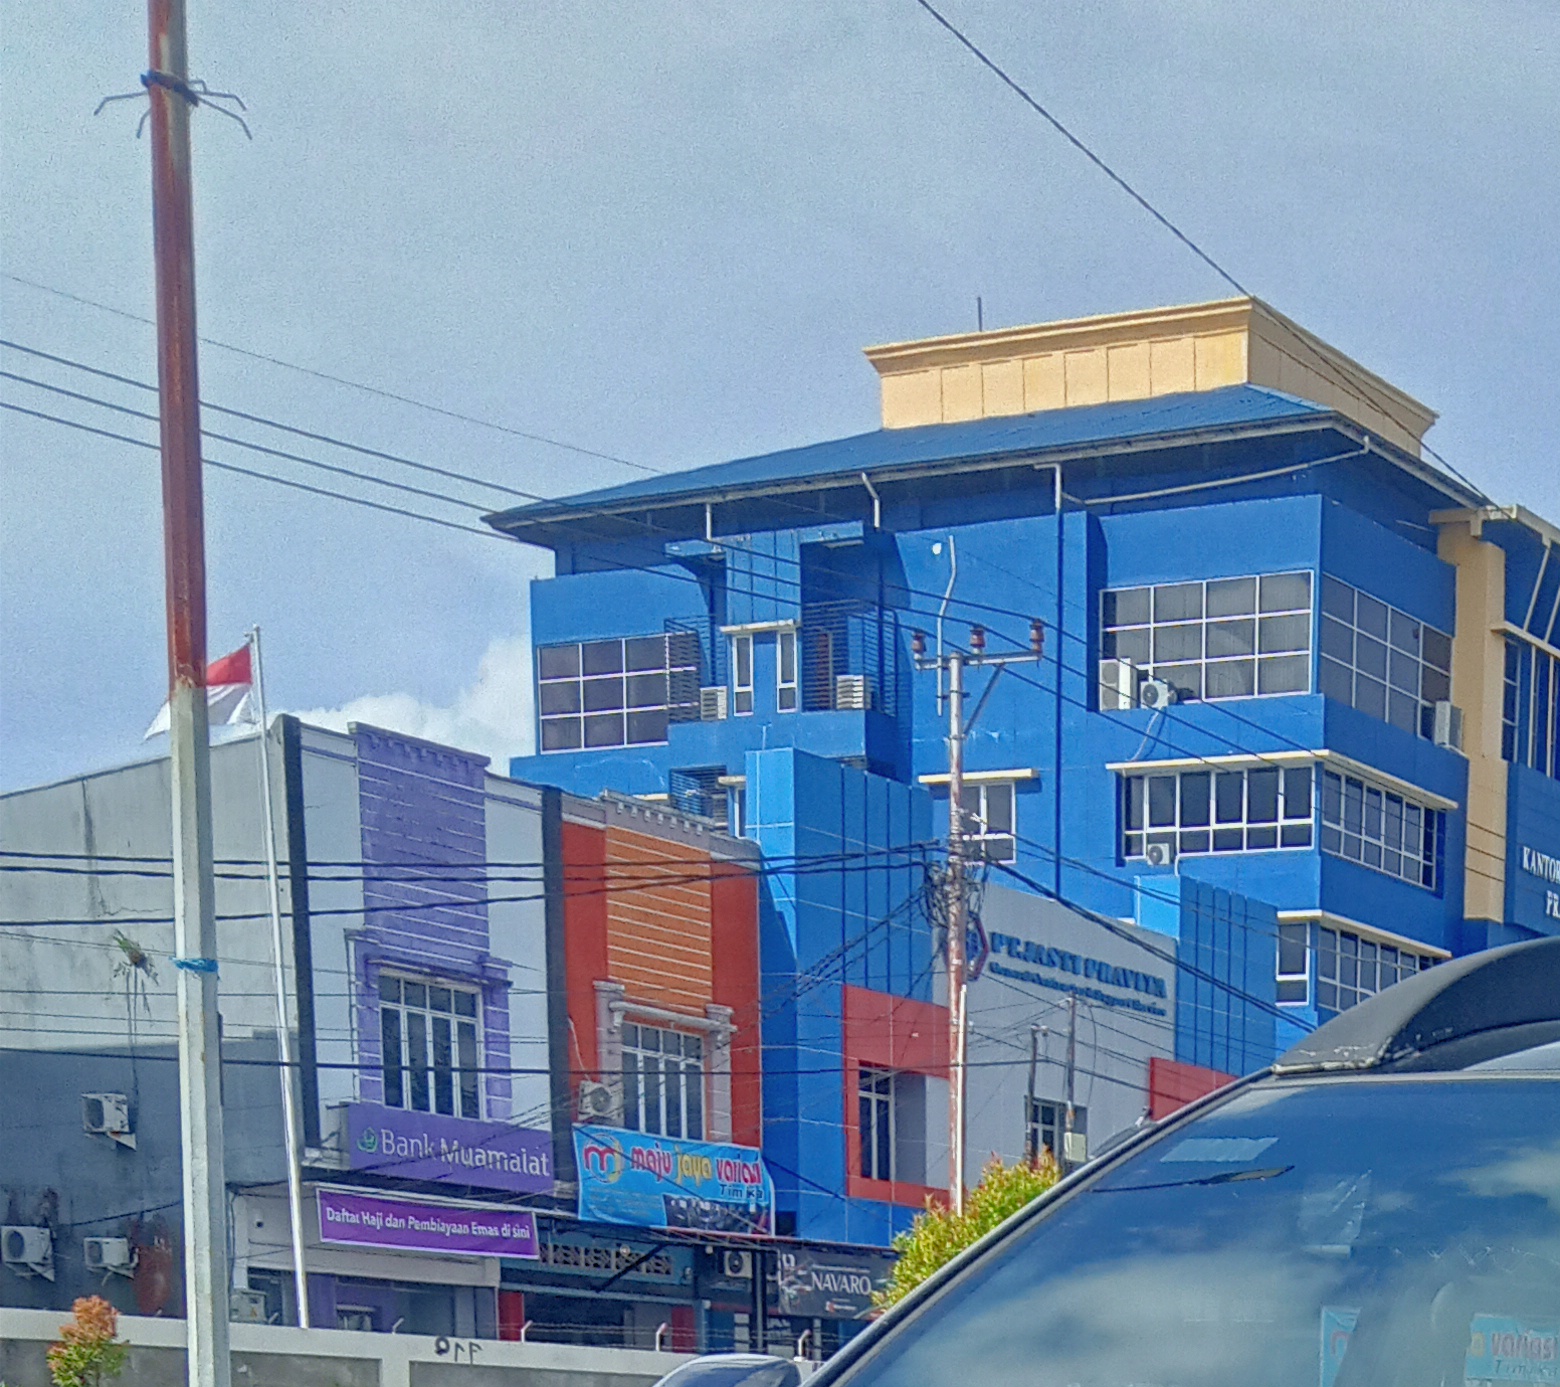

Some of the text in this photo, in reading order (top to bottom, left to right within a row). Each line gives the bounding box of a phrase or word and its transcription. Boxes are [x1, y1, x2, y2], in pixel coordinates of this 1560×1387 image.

[381, 1128, 550, 1177] Bank Muamalat
[631, 1141, 673, 1184] maju
[675, 1143, 713, 1188] jaya
[326, 1206, 530, 1240] Daftar Haji dan Pembiayaan Emas di sini
[811, 1271, 872, 1296] NAVARO
